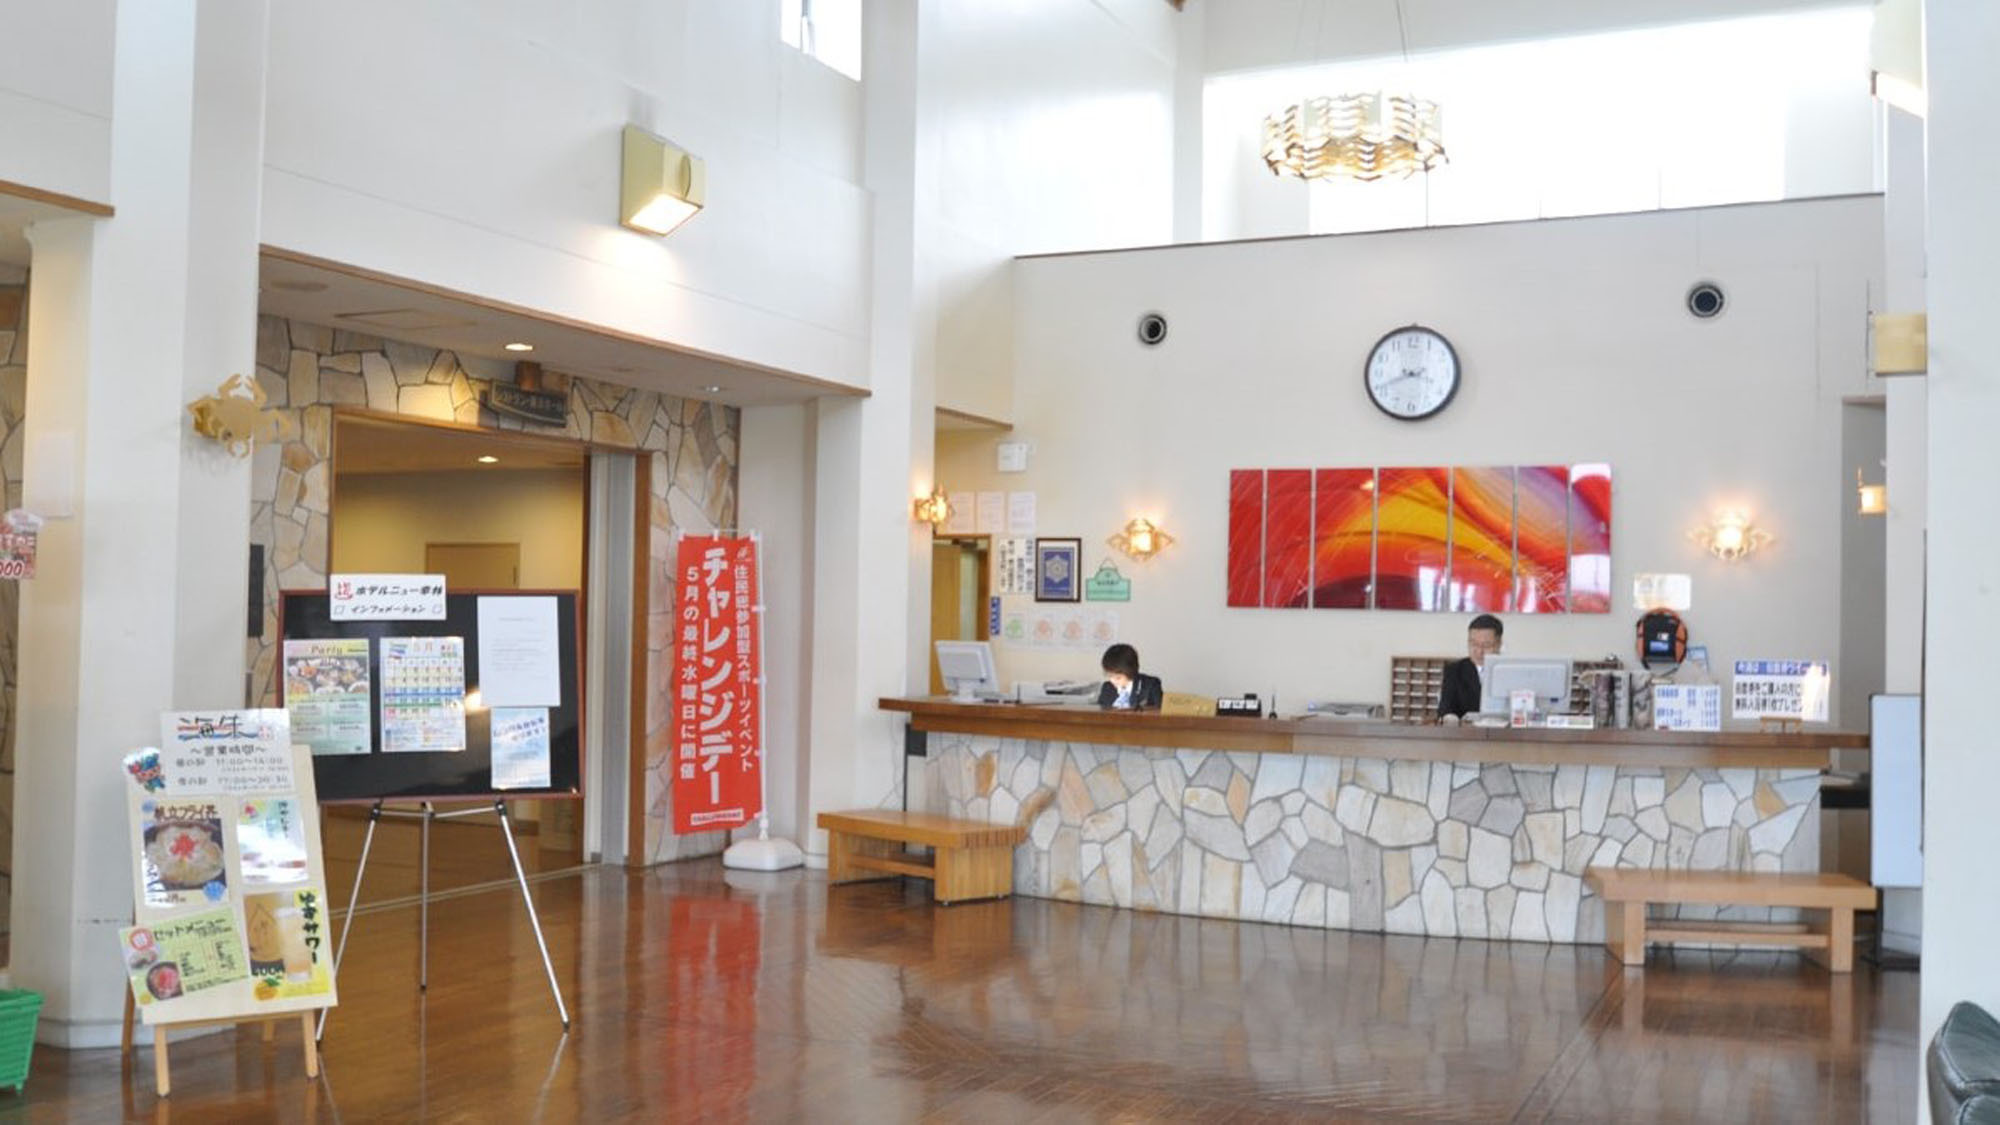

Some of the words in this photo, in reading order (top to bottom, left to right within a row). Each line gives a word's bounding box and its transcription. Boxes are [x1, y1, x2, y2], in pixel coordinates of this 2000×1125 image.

[1392, 339, 1401, 352] 11
[1407, 336, 1420, 349] 12
[1378, 352, 1389, 363] 10
[1407, 400, 1415, 411] 6
[351, 605, 426, 614] インフォメーション
[700, 548, 733, 804] チャレンジデー
[153, 917, 227, 942] セットメニュー
